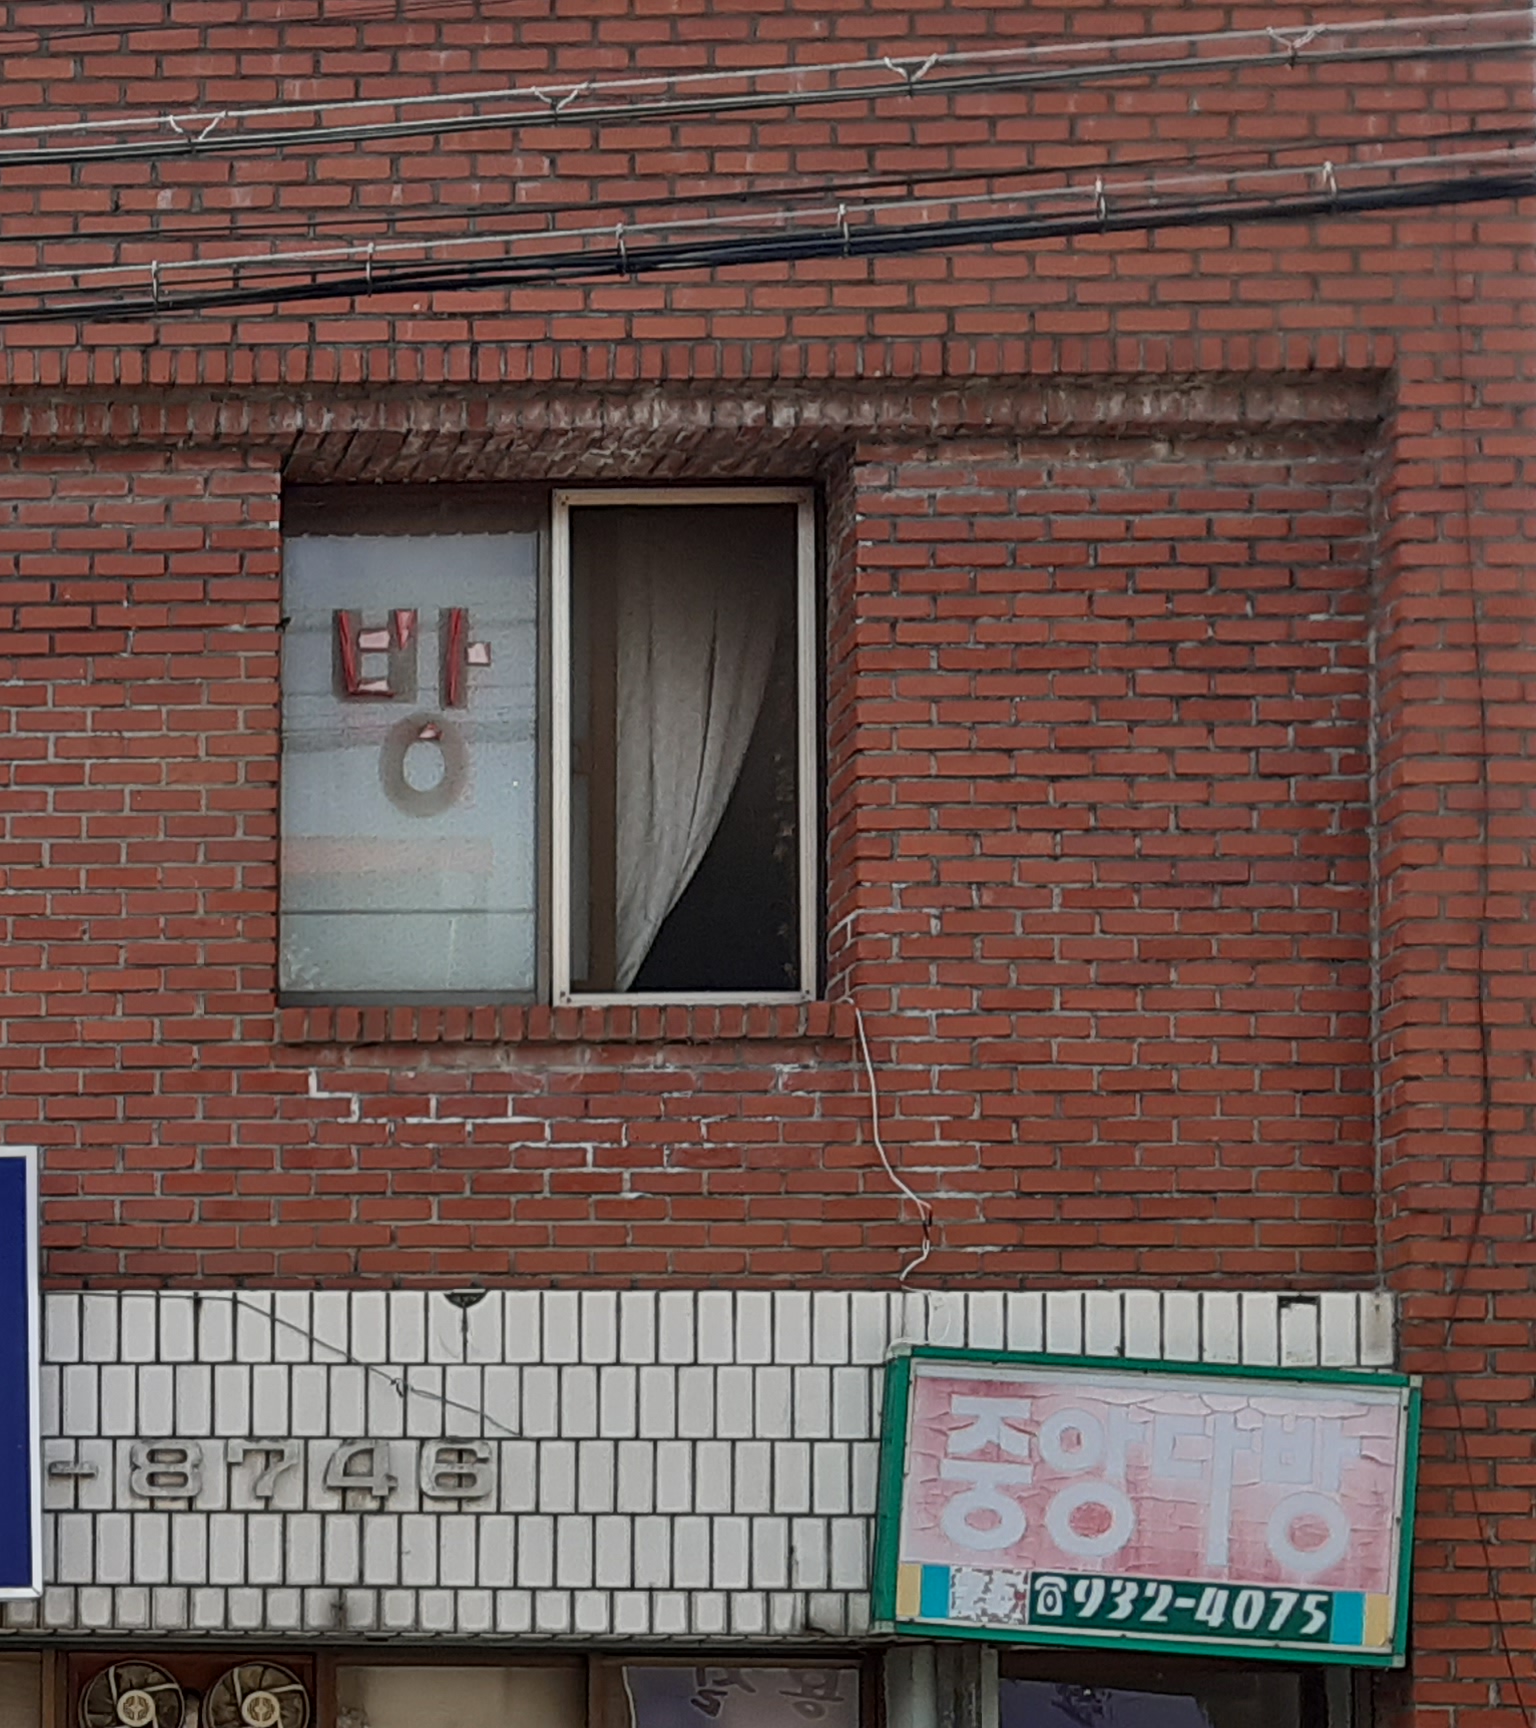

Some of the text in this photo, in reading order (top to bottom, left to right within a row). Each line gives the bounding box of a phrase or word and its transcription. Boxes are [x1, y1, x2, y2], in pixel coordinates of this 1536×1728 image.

[332, 608, 491, 818] 방
[939, 1395, 1362, 1576] 중앙다방
[1072, 1577, 1328, 1636] 932-4075
